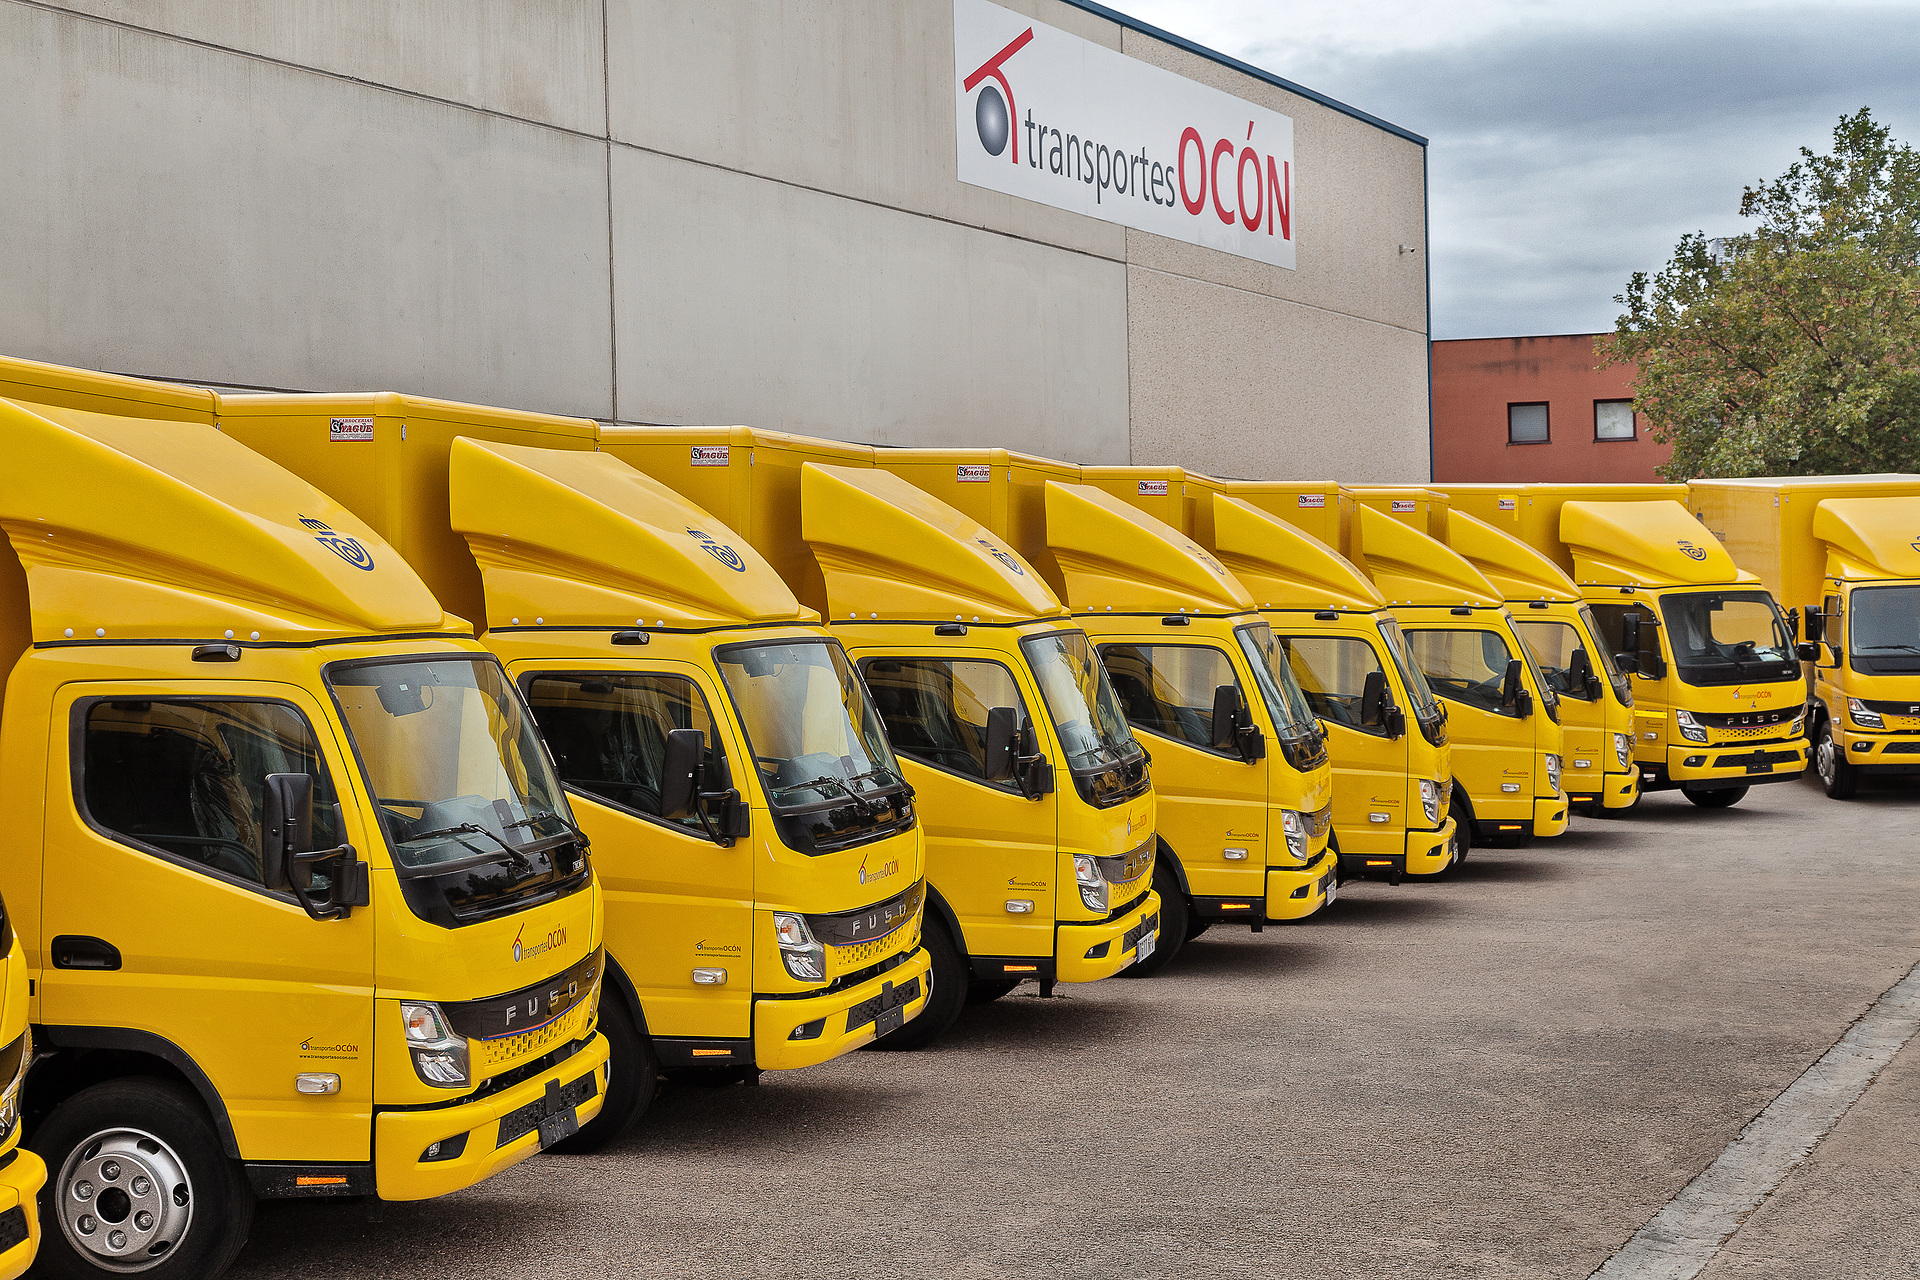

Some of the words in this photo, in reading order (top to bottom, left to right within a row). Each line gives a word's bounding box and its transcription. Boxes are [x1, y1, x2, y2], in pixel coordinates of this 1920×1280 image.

[341, 422, 374, 433] YAGÜE
[1727, 714, 1779, 726] FUSO
[852, 903, 907, 936] FUSO
[505, 980, 578, 1026] FUSO
